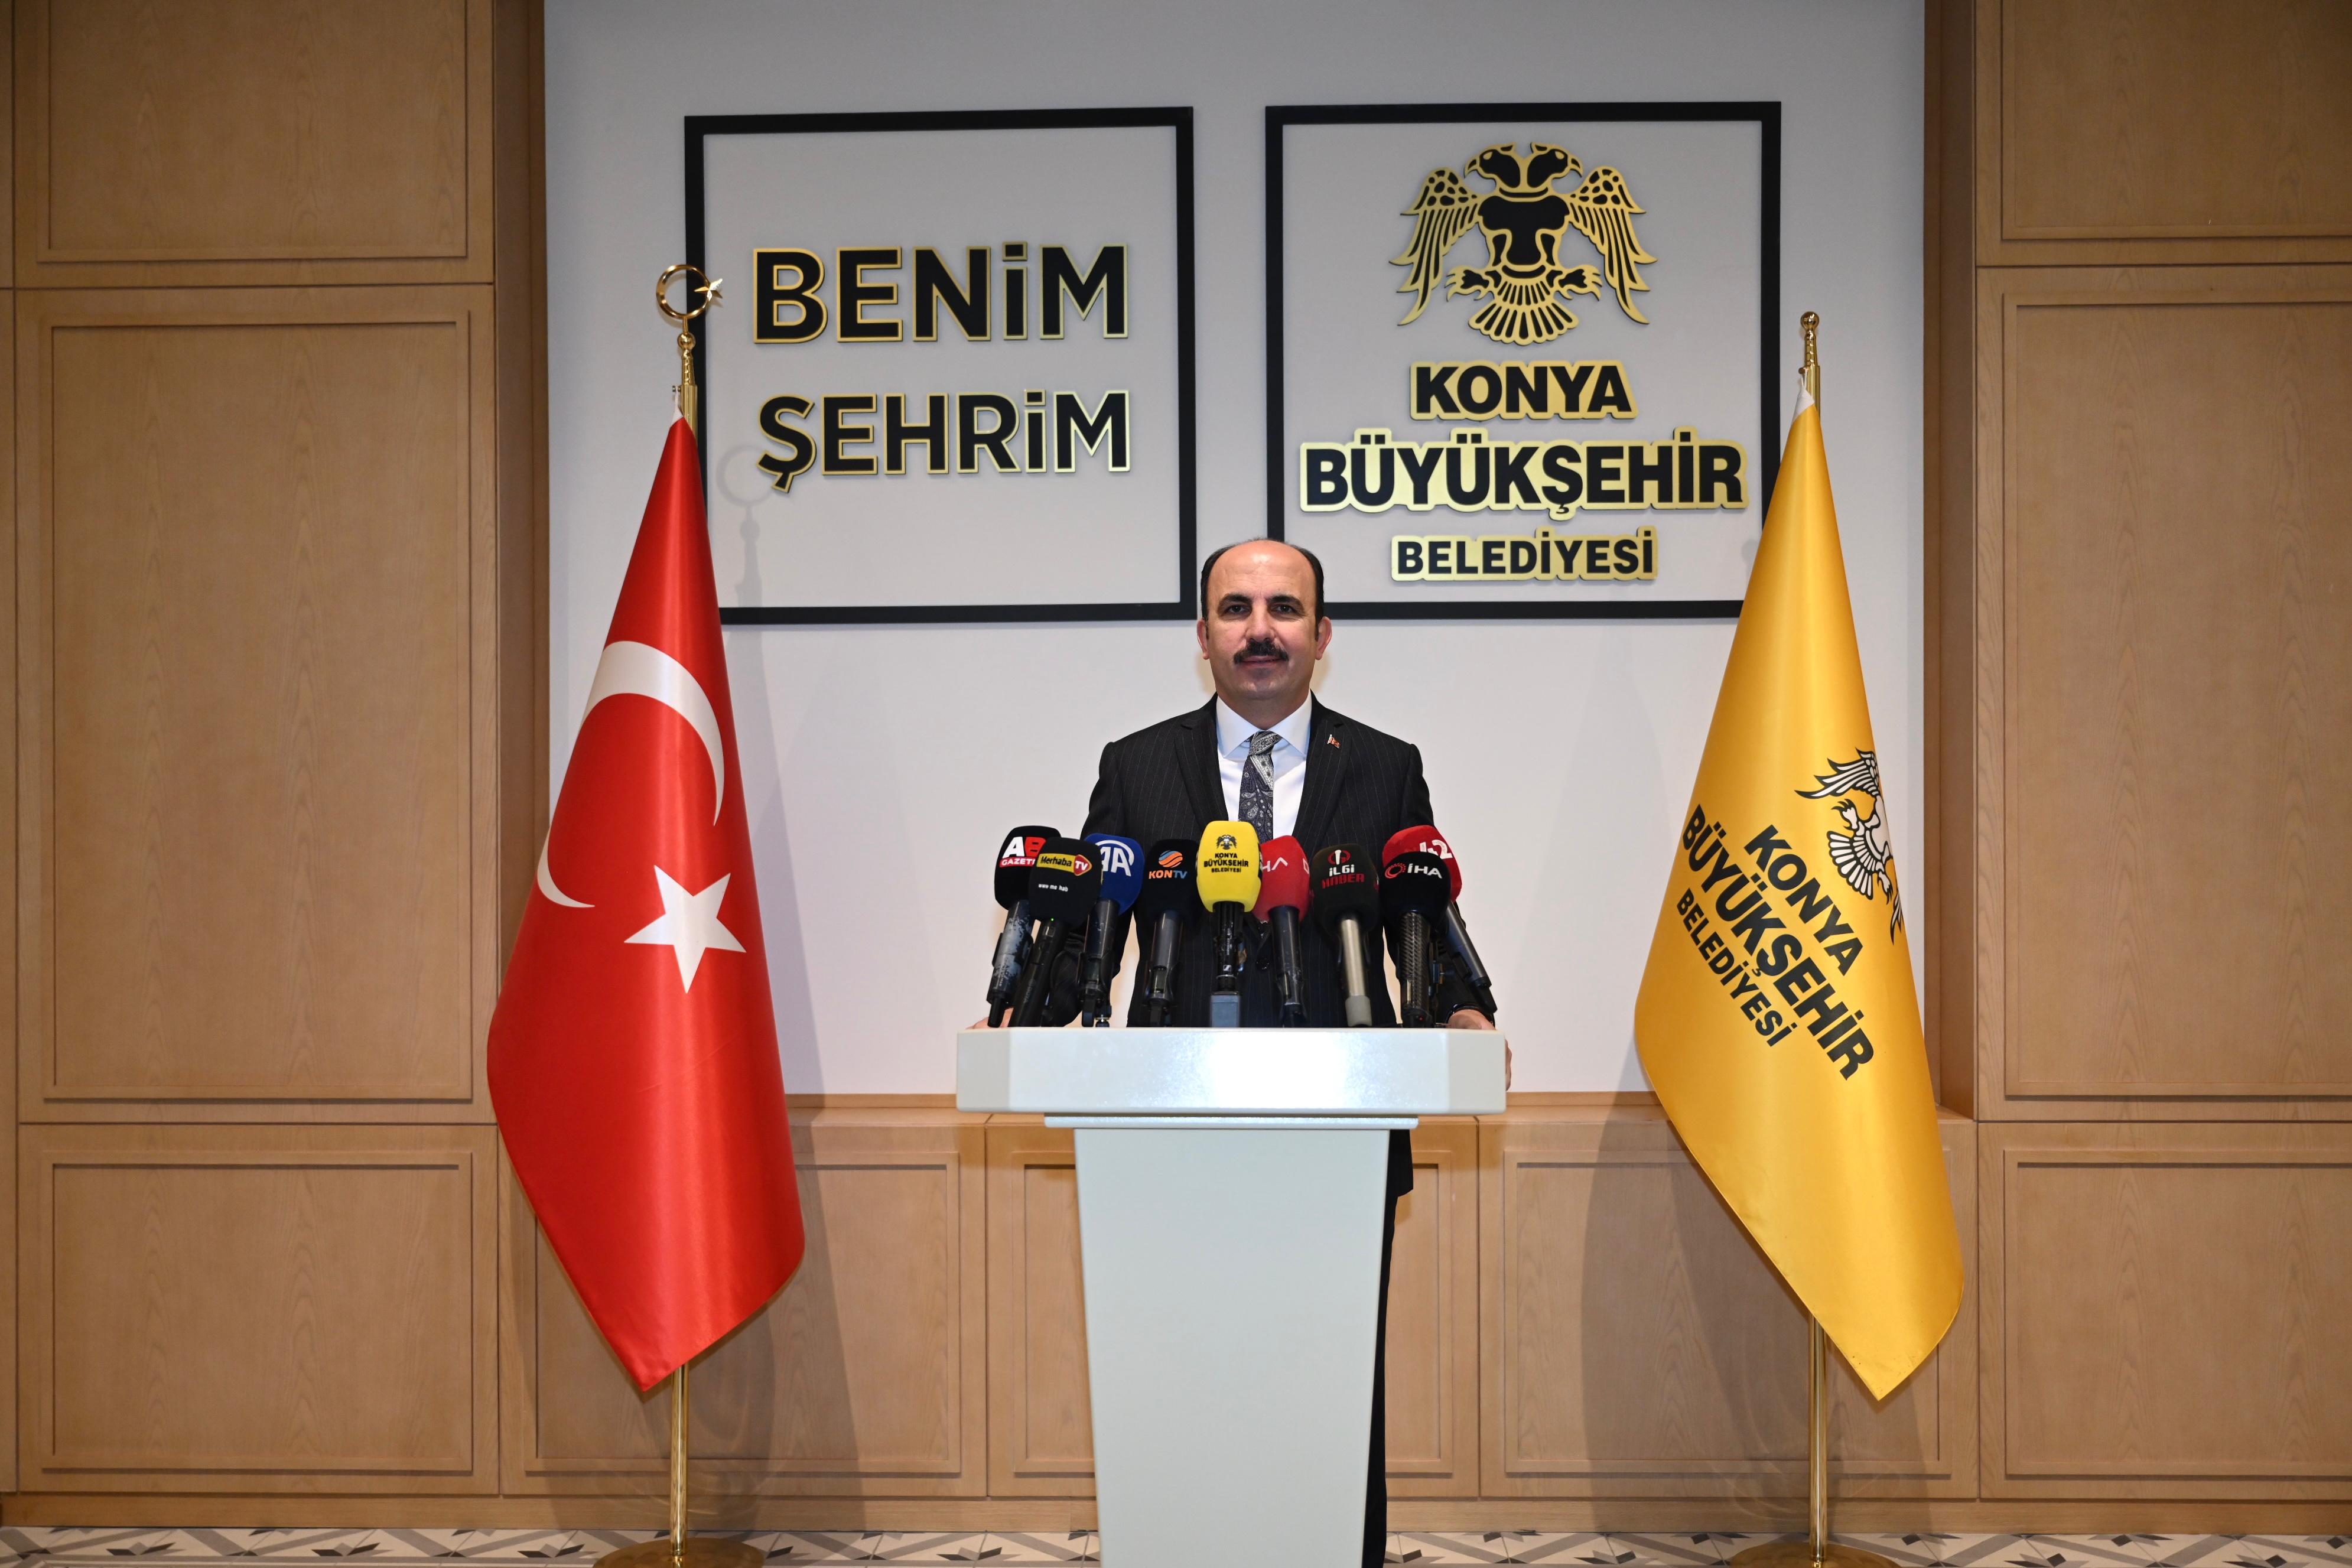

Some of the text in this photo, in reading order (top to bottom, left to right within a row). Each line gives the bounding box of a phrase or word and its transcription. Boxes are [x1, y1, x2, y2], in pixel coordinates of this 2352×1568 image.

[1414, 364, 1634, 415] KONYA
[1305, 431, 1745, 514] BÜYÜKŞEHİR
[1396, 529, 1653, 575] BELEDİYESİ
[1040, 856, 1088, 871] Merhaba TV
[1149, 870, 1188, 879] KONTV
[1407, 863, 1442, 879] İHA
[1744, 824, 1864, 977] KONYA
[1676, 887, 1798, 1047] BELEDİYESİ
[1681, 803, 1875, 1081] BÜYÜKŞEHİR
